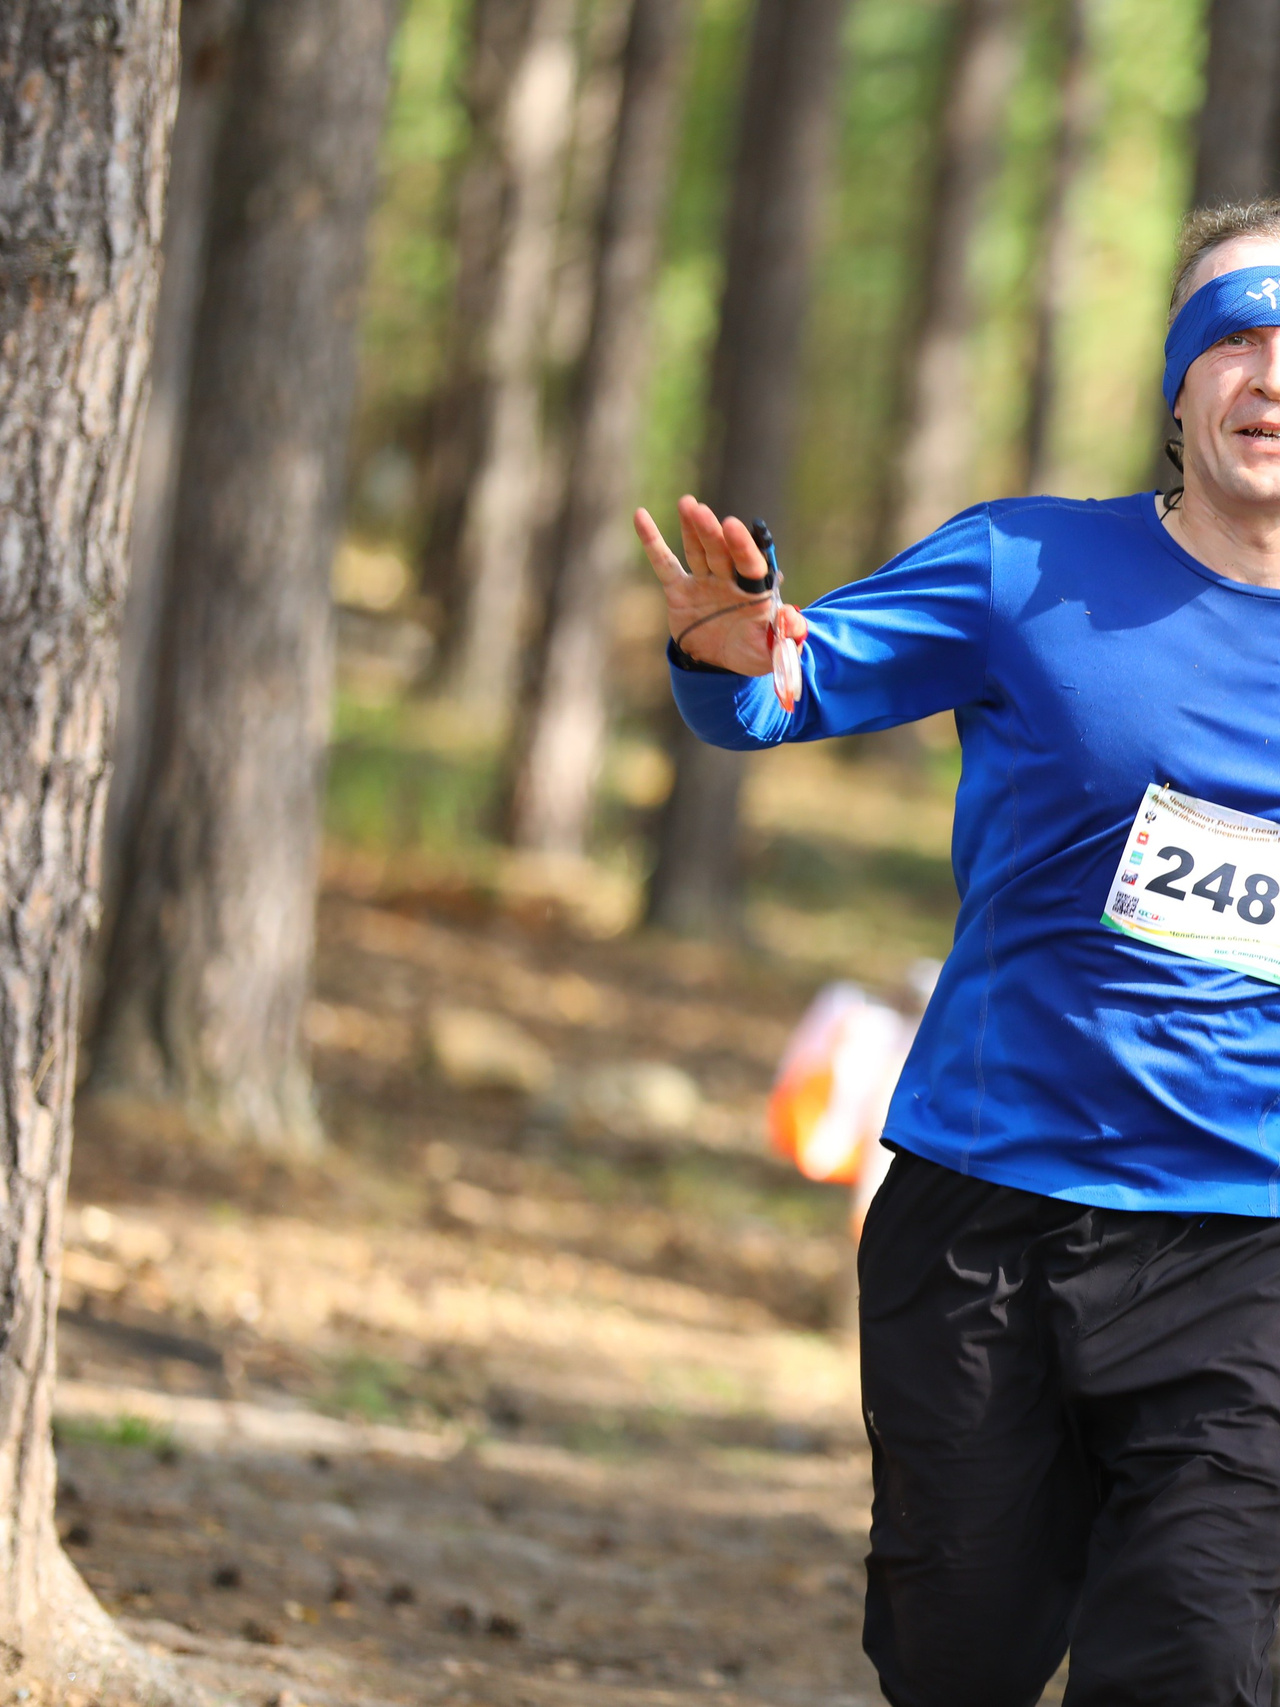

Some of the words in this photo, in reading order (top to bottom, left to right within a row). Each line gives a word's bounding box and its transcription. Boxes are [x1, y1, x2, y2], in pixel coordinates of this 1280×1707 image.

[1169, 795, 1214, 823] Чемпионат
[1217, 819, 1249, 832] России
[1251, 826, 1279, 837] среди
[1144, 846, 1280, 925] 248
[1169, 930, 1226, 942] Челябинская
